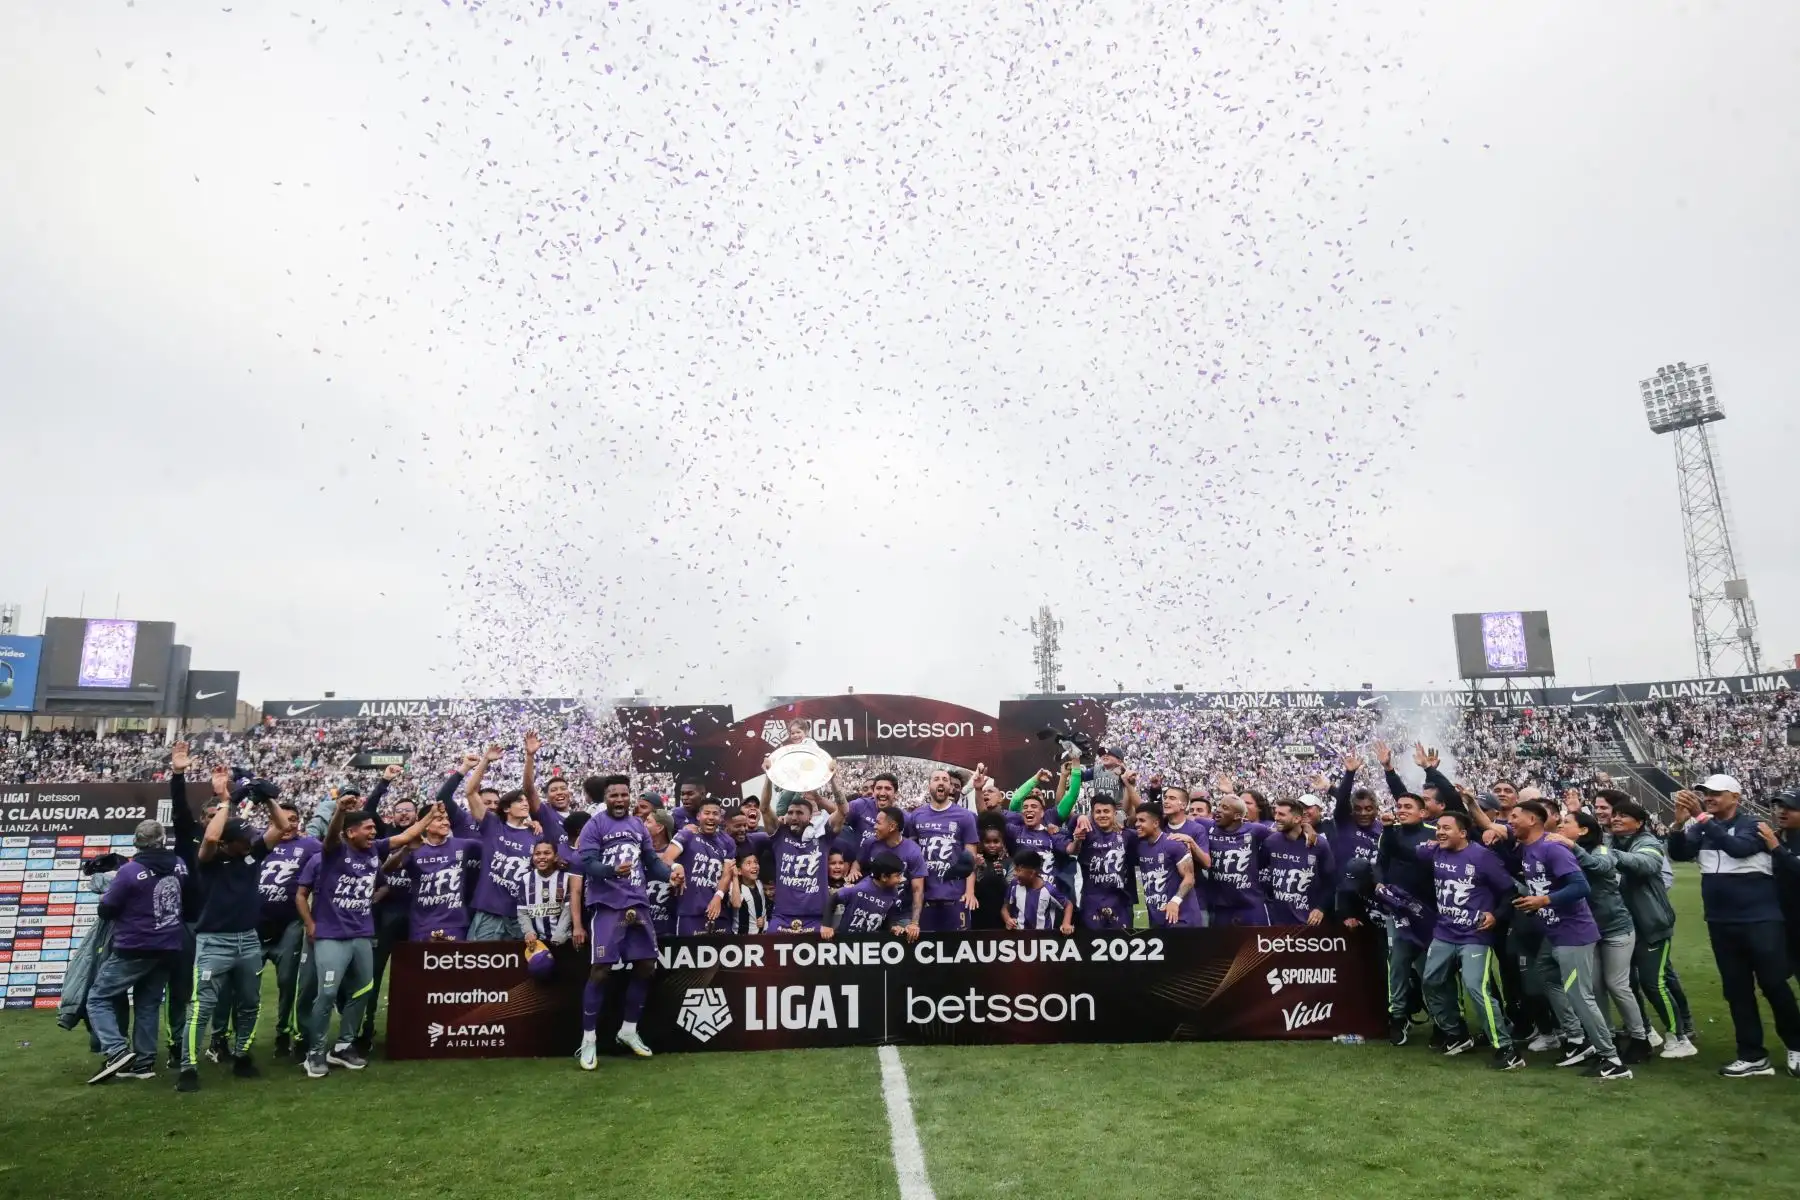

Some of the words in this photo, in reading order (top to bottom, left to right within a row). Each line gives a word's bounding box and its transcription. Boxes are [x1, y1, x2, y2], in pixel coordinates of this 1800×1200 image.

[1648, 680, 1731, 699] ALIANZA
[1739, 675, 1791, 693] LIMA
[1214, 693, 1280, 708] ALIANZA
[1287, 693, 1325, 708] LIMA
[1420, 691, 1487, 707] ALIANZA
[1494, 691, 1534, 706] LIMA
[358, 702, 430, 717] ALIANZA
[806, 718, 854, 742] IGA1
[877, 719, 975, 739] betsson
[1287, 745, 1313, 754] SALIDA
[3, 793, 30, 803] LIGA1
[38, 793, 81, 802] betsson
[8, 807, 100, 820] CLAUSURA
[104, 806, 147, 819] 2022
[1016, 838, 1043, 846] GLORY
[1354, 845, 1371, 856] CON
[416, 855, 449, 864] GLORY
[694, 853, 709, 863] CON
[782, 853, 795, 864] CON
[1271, 853, 1300, 863] GLORY
[692, 862, 706, 874] LA
[781, 863, 792, 874] LA
[1273, 868, 1286, 877] CON
[1434, 861, 1458, 873] LORY
[419, 882, 432, 894] LA
[1272, 877, 1283, 889] LA
[857, 891, 886, 908] GLORY
[850, 916, 865, 928] LA
[1257, 934, 1347, 953] betsson
[611, 944, 765, 970] NADOR
[773, 942, 904, 967] TORNEO
[914, 939, 1083, 964] CLAUSURA
[1091, 938, 1165, 961] 2022
[424, 951, 519, 970] betsson
[1281, 968, 1337, 984] SPORADE
[427, 988, 509, 1005] marathon
[745, 984, 859, 1031] LIGA1
[906, 987, 1096, 1024] betsson
[1282, 1001, 1333, 1031] Vida
[447, 1025, 506, 1037] LATAM
[447, 1039, 506, 1048] AIRLINES
